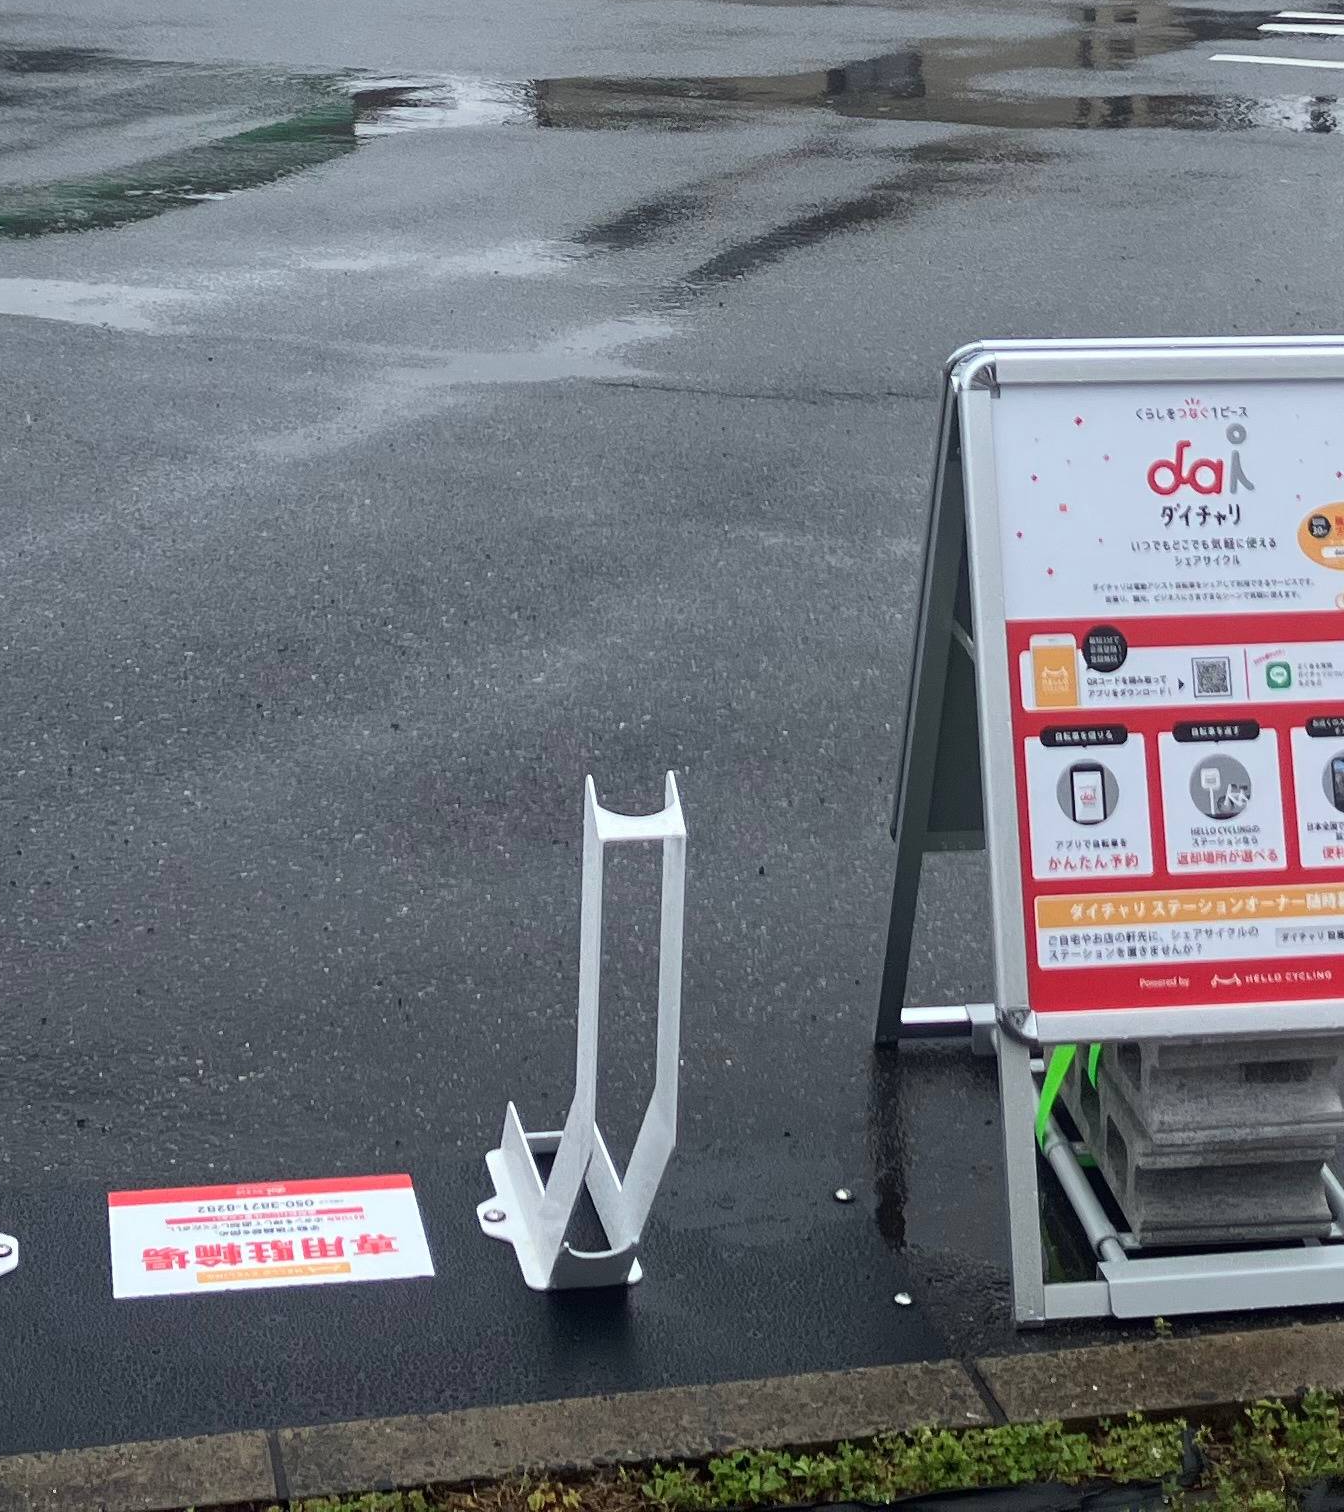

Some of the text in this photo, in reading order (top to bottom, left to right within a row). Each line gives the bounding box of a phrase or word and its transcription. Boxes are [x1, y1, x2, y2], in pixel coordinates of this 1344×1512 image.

[1160, 502, 1241, 527] ダイチャリ
[1131, 536, 1277, 553] いつでもどこでも気軽に使える
[1174, 553, 1241, 567] シェアサイクル
[1048, 852, 1139, 872] かんたん予約
[1177, 849, 1278, 865] 返却場所が選べる
[1070, 901, 1146, 921] ダイチャリ
[1139, 975, 1190, 989] Powered by
[1245, 970, 1333, 984] HELLO CYCLING
[142, 1233, 399, 1271] 専用駐輪場
